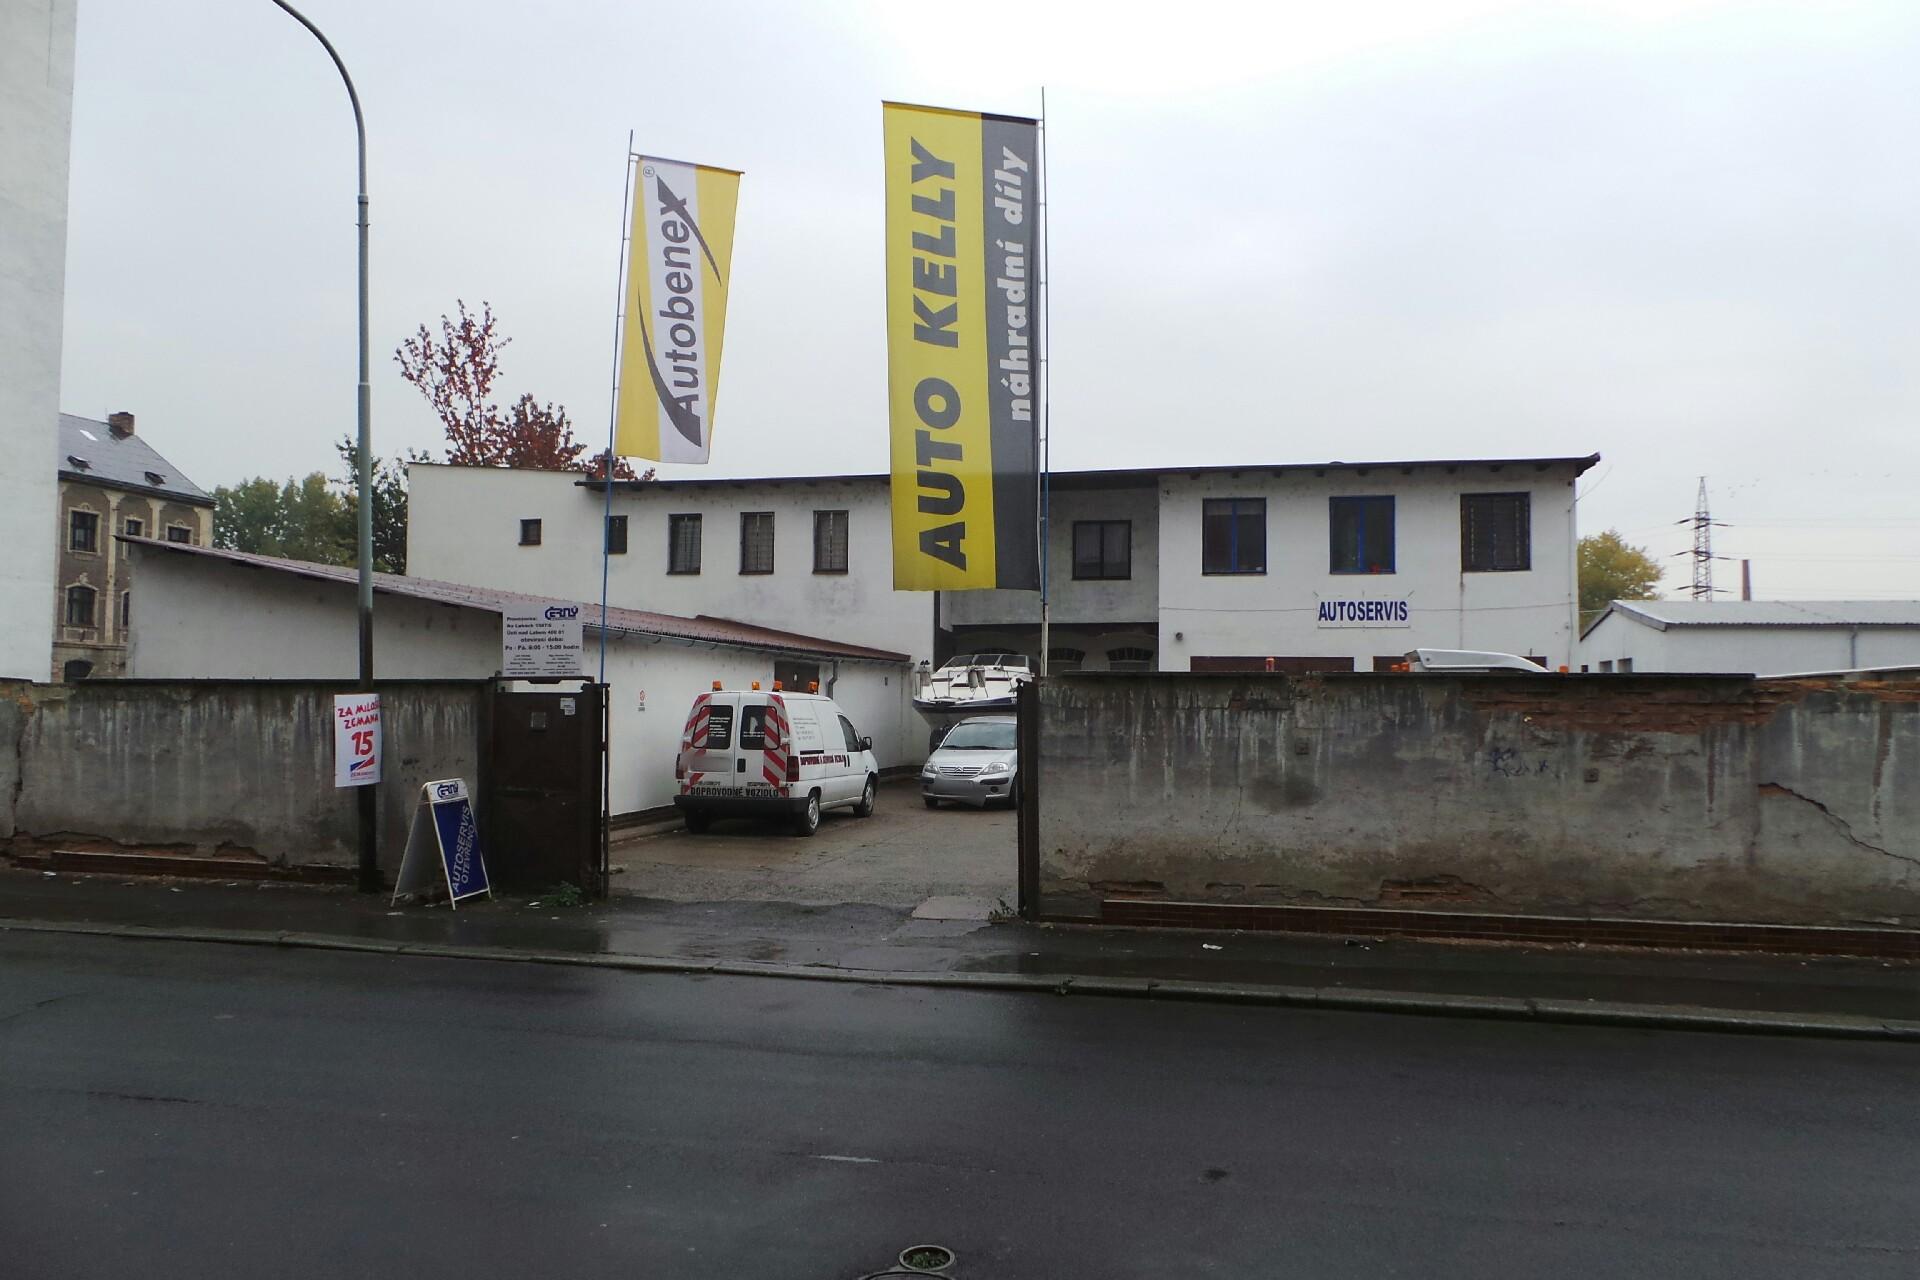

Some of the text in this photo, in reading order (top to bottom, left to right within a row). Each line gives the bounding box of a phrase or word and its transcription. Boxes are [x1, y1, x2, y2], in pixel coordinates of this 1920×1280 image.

[994, 146, 1032, 422] náhradní díly
[649, 174, 708, 448] Autobenex
[910, 136, 967, 572] AUTO KELLY
[1318, 601, 1408, 621] AUTOSERVIS
[338, 707, 353, 717] ZA
[344, 713, 379, 730] ZEMANA
[351, 730, 373, 756] 15
[691, 787, 779, 797] DOPROVODNÉ VOZIDLO
[451, 804, 470, 893] AUTOSERVIS
